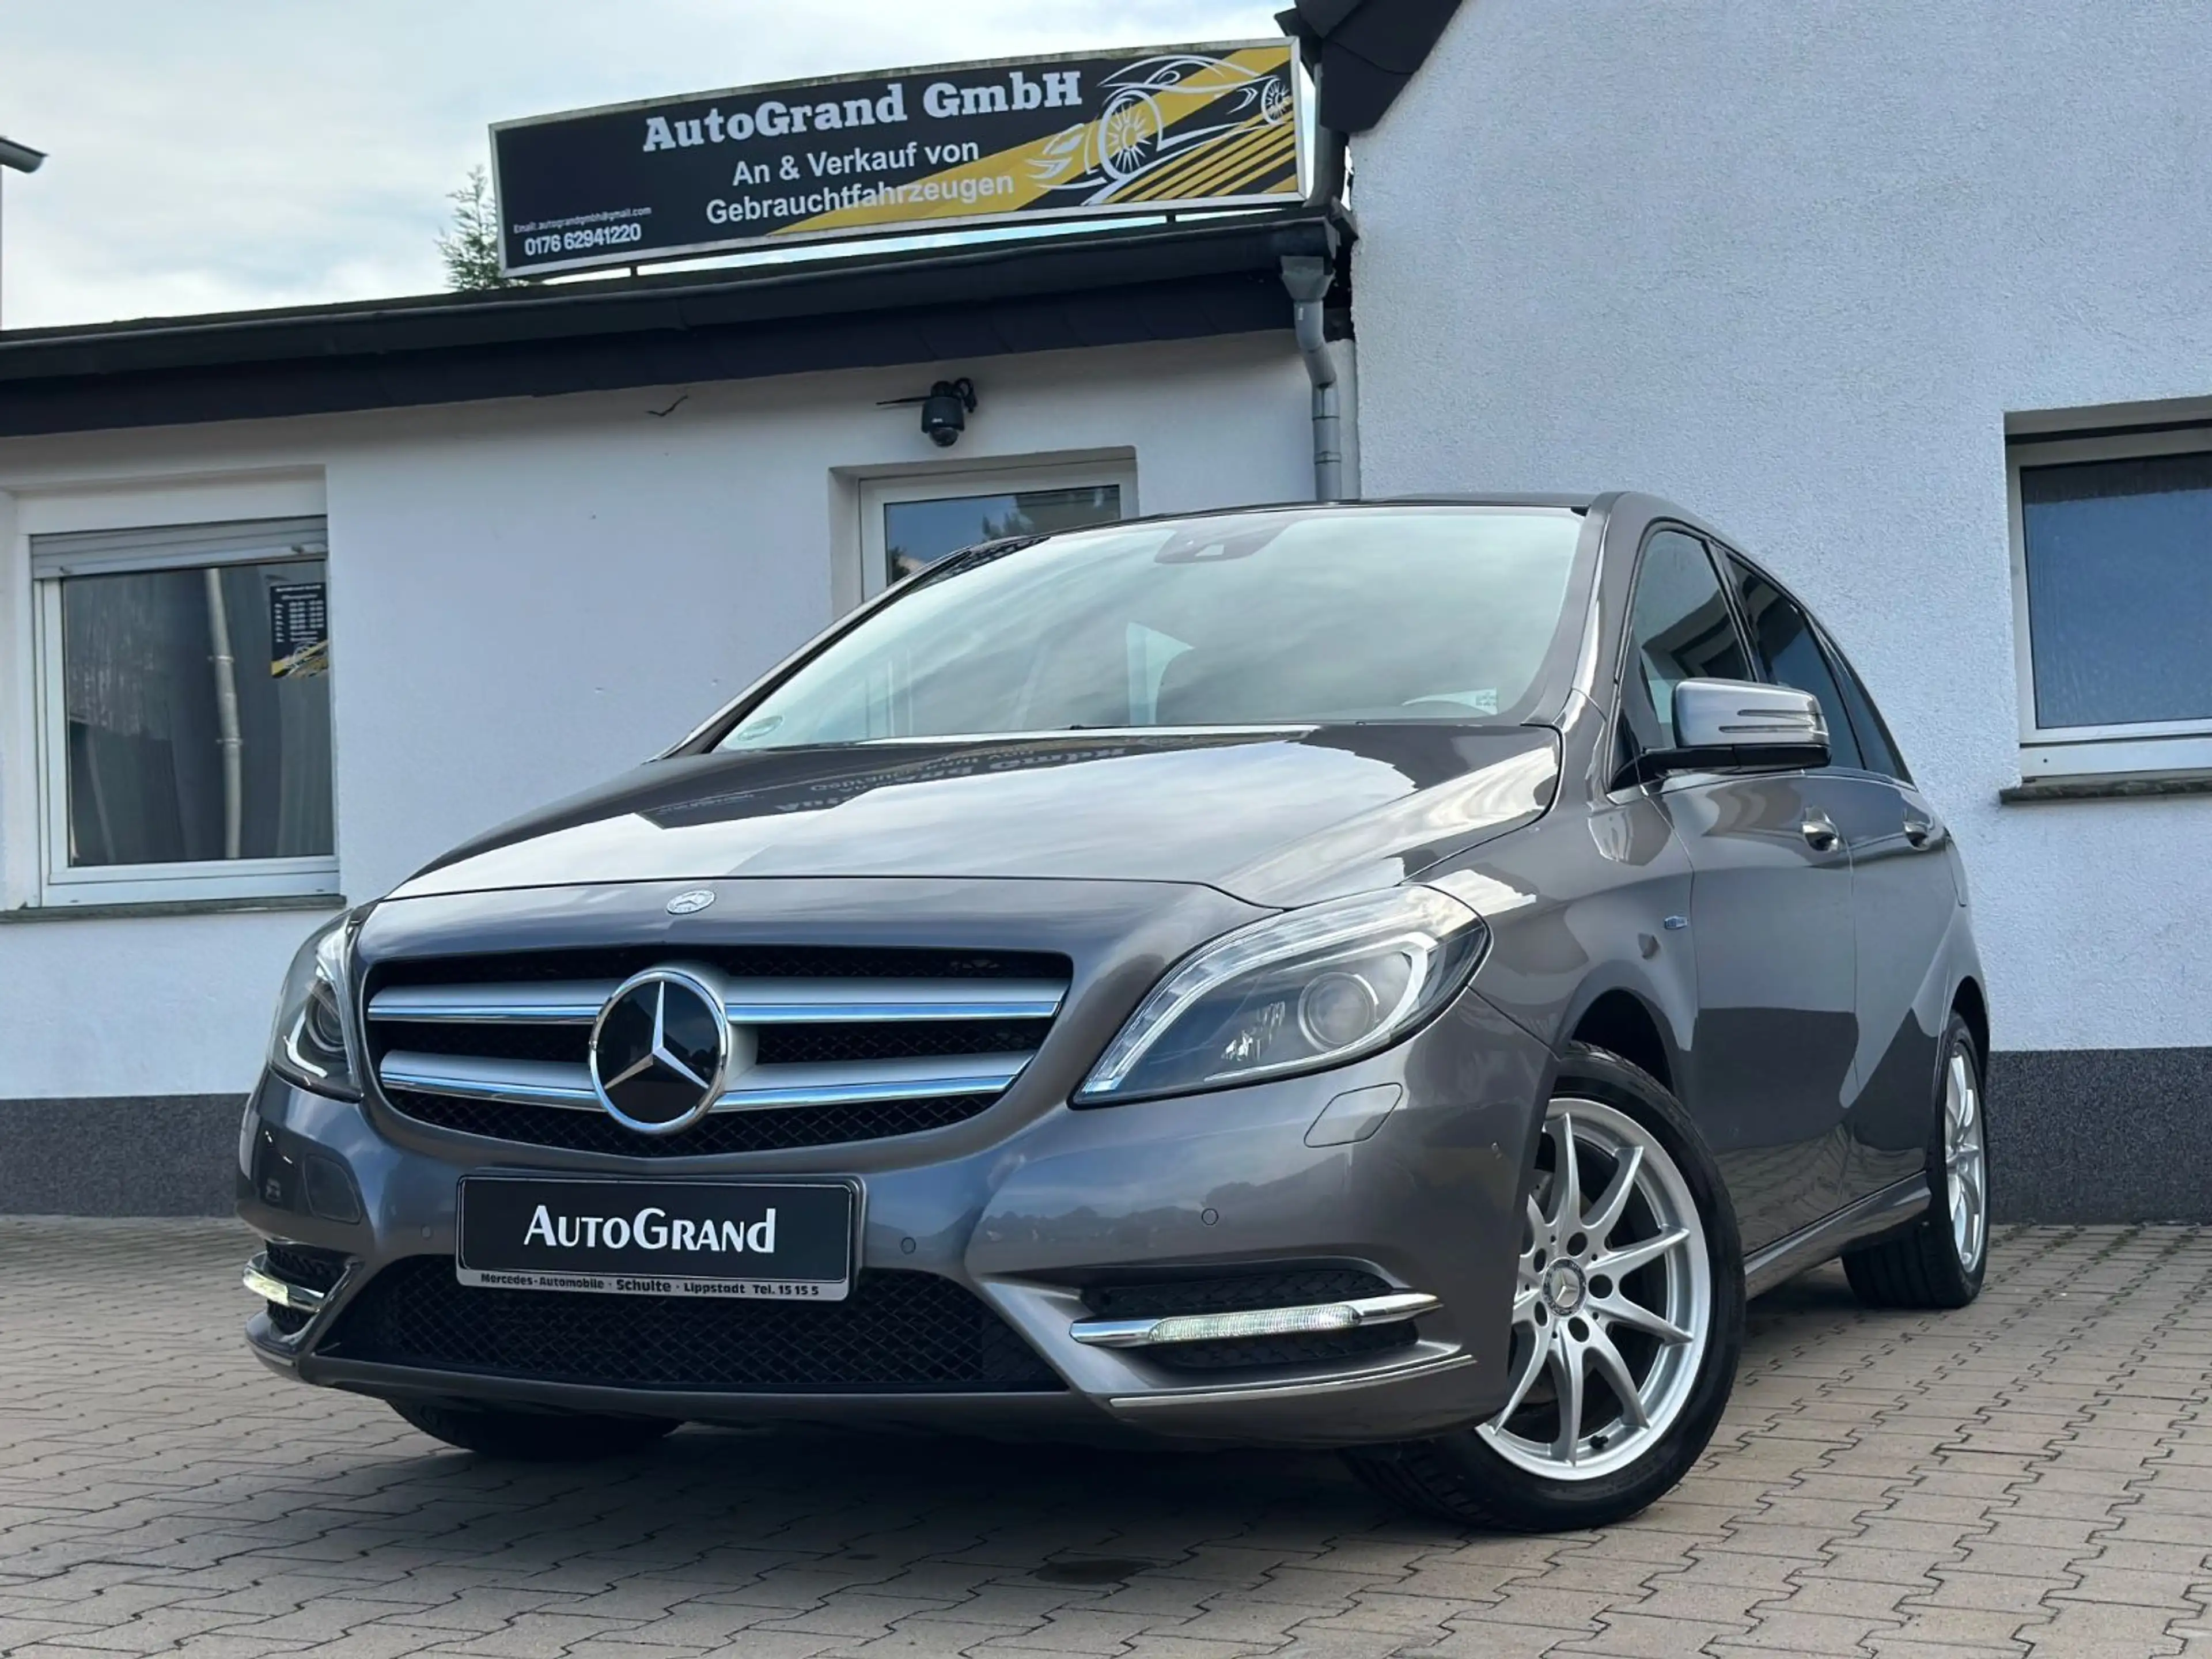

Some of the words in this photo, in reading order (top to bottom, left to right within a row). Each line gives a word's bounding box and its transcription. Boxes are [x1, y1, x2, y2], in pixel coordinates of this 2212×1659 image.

[642, 82, 908, 152] AutoGrand
[923, 70, 1083, 118] GmbH
[732, 161, 770, 187] An
[779, 155, 800, 180] &
[807, 142, 918, 177] Verkauf
[925, 142, 979, 165] von
[706, 175, 1014, 224] Gebrauchtfahrzeugen
[524, 234, 561, 256] 0176
[563, 223, 642, 250] 62941220
[616, 1279, 672, 1293] Schulte
[684, 1282, 745, 1294] Lippstadt
[752, 1284, 776, 1295] Tel.
